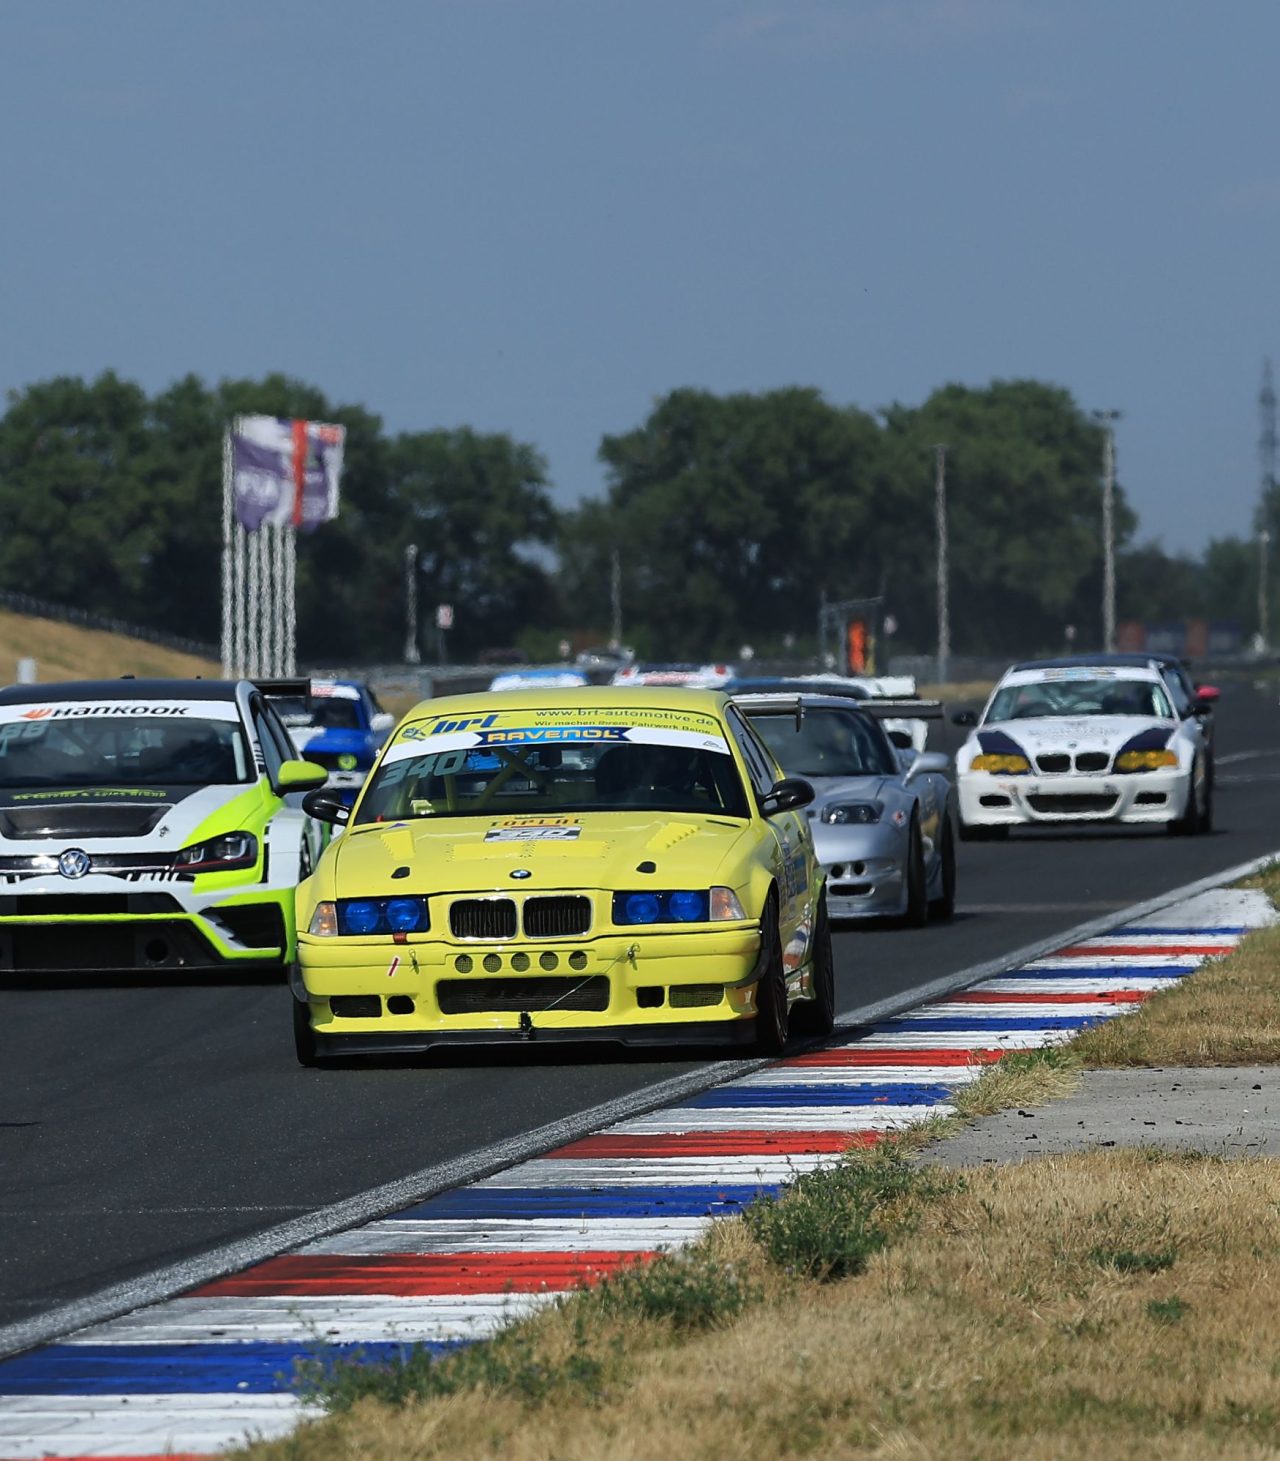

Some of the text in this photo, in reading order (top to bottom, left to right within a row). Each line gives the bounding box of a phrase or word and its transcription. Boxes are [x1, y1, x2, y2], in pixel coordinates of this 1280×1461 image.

[536, 708, 714, 726] www.brt-automotive.de
[487, 729, 620, 742] RAVENOL
[376, 750, 467, 789] 340
